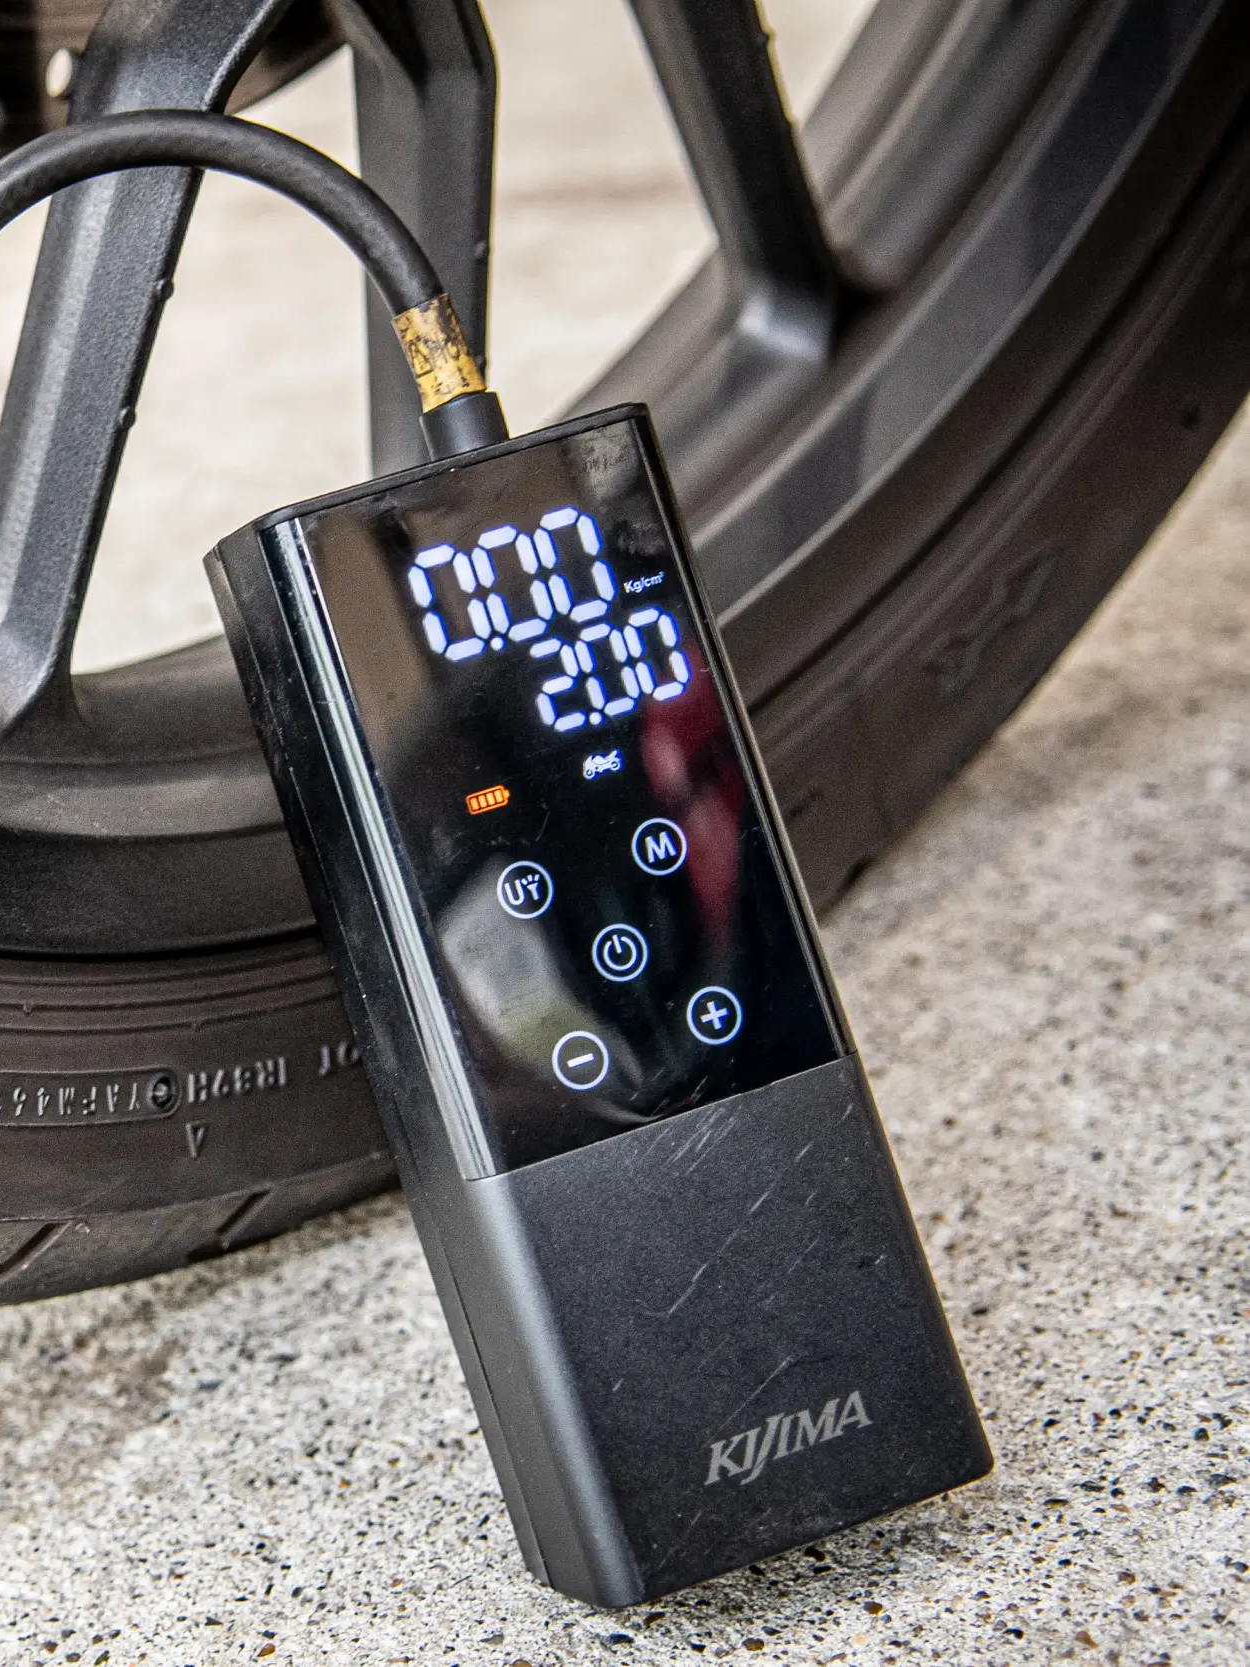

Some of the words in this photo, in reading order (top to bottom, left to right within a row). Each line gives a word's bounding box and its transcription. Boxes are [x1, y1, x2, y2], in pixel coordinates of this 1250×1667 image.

[407, 505, 618, 662] 0.00
[529, 605, 691, 732] 2.00
[644, 832, 677, 863] M
[704, 1389, 874, 1486] KIJIMA
